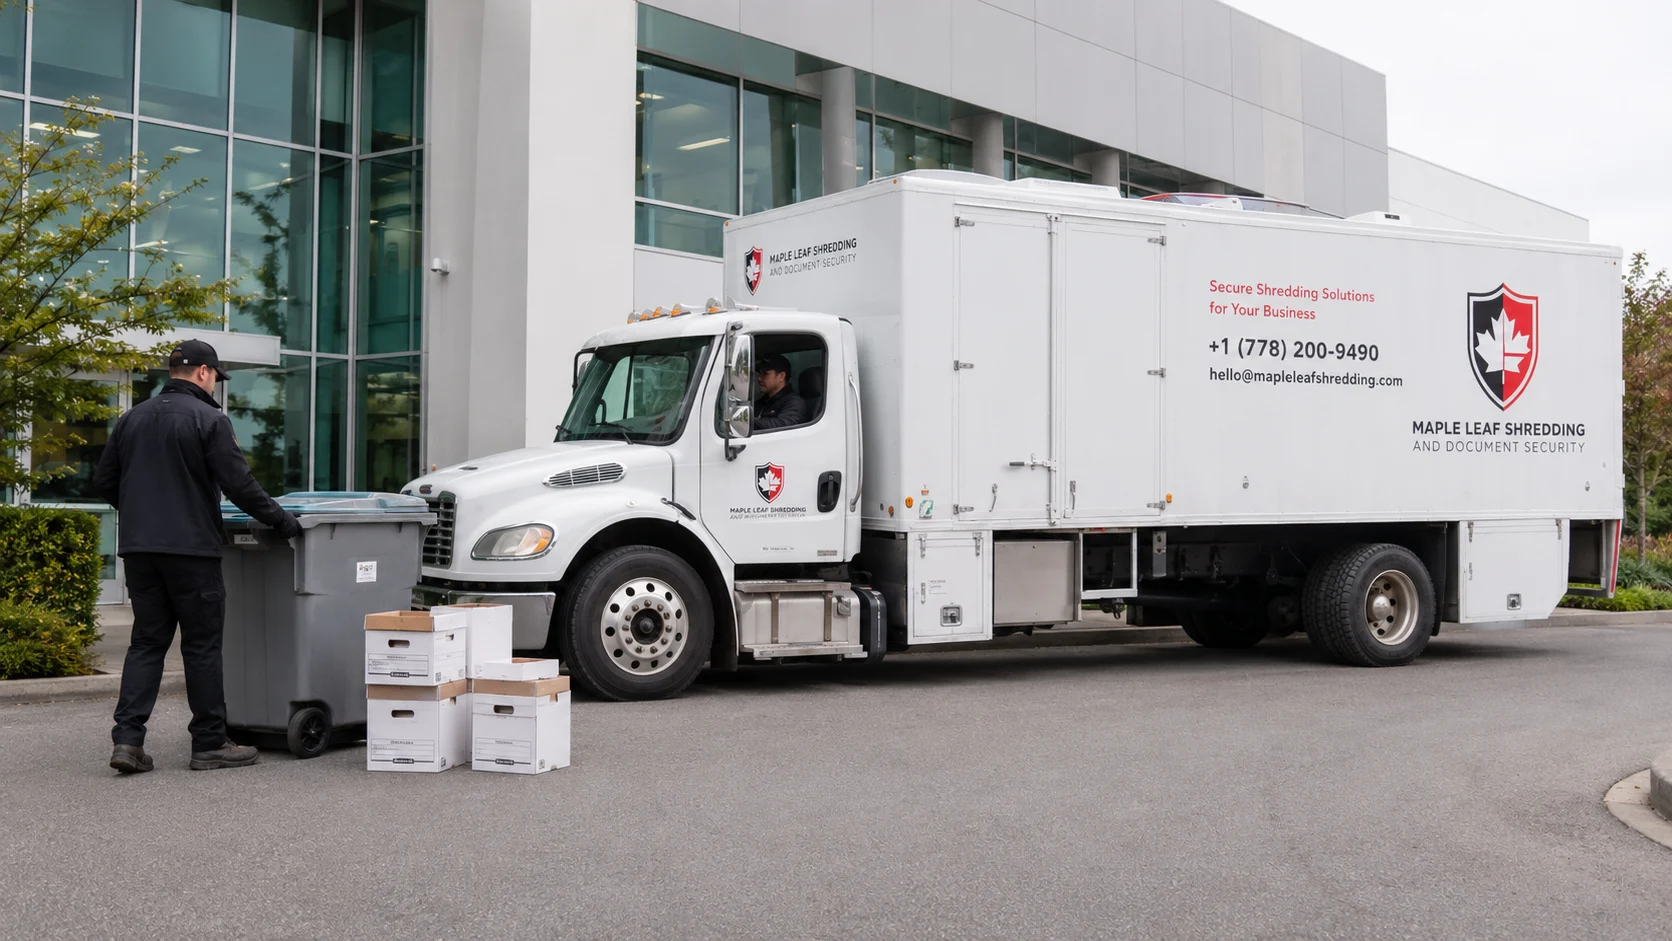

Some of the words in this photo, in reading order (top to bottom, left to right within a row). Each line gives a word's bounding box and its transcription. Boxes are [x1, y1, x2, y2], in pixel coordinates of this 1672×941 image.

[770, 251, 793, 264] MAPLE
[794, 247, 811, 259] LEAF
[814, 238, 857, 256] SHREDDING
[770, 266, 782, 276] AND
[784, 260, 820, 274] DOCUMENT
[822, 254, 856, 268] SECURITY
[1210, 280, 1253, 294] Secure
[1256, 284, 1318, 302] Shredding
[1322, 288, 1375, 302] Solutions
[1210, 302, 1228, 314] for
[1232, 303, 1260, 316] Your
[1264, 304, 1316, 320] Business
[1209, 338, 1229, 354] +1
[1238, 338, 1287, 360] (778)
[1294, 340, 1379, 362] 200-9490
[1210, 367, 1403, 388] hello@mapleleafshredding.com
[1412, 421, 1460, 434] MAPLE
[1466, 422, 1500, 436] LEAF
[1505, 422, 1586, 436] SHREDDING
[1413, 440, 1440, 452] AND
[1446, 441, 1519, 452] DOCUMENT
[1524, 442, 1585, 453] SECURITY
